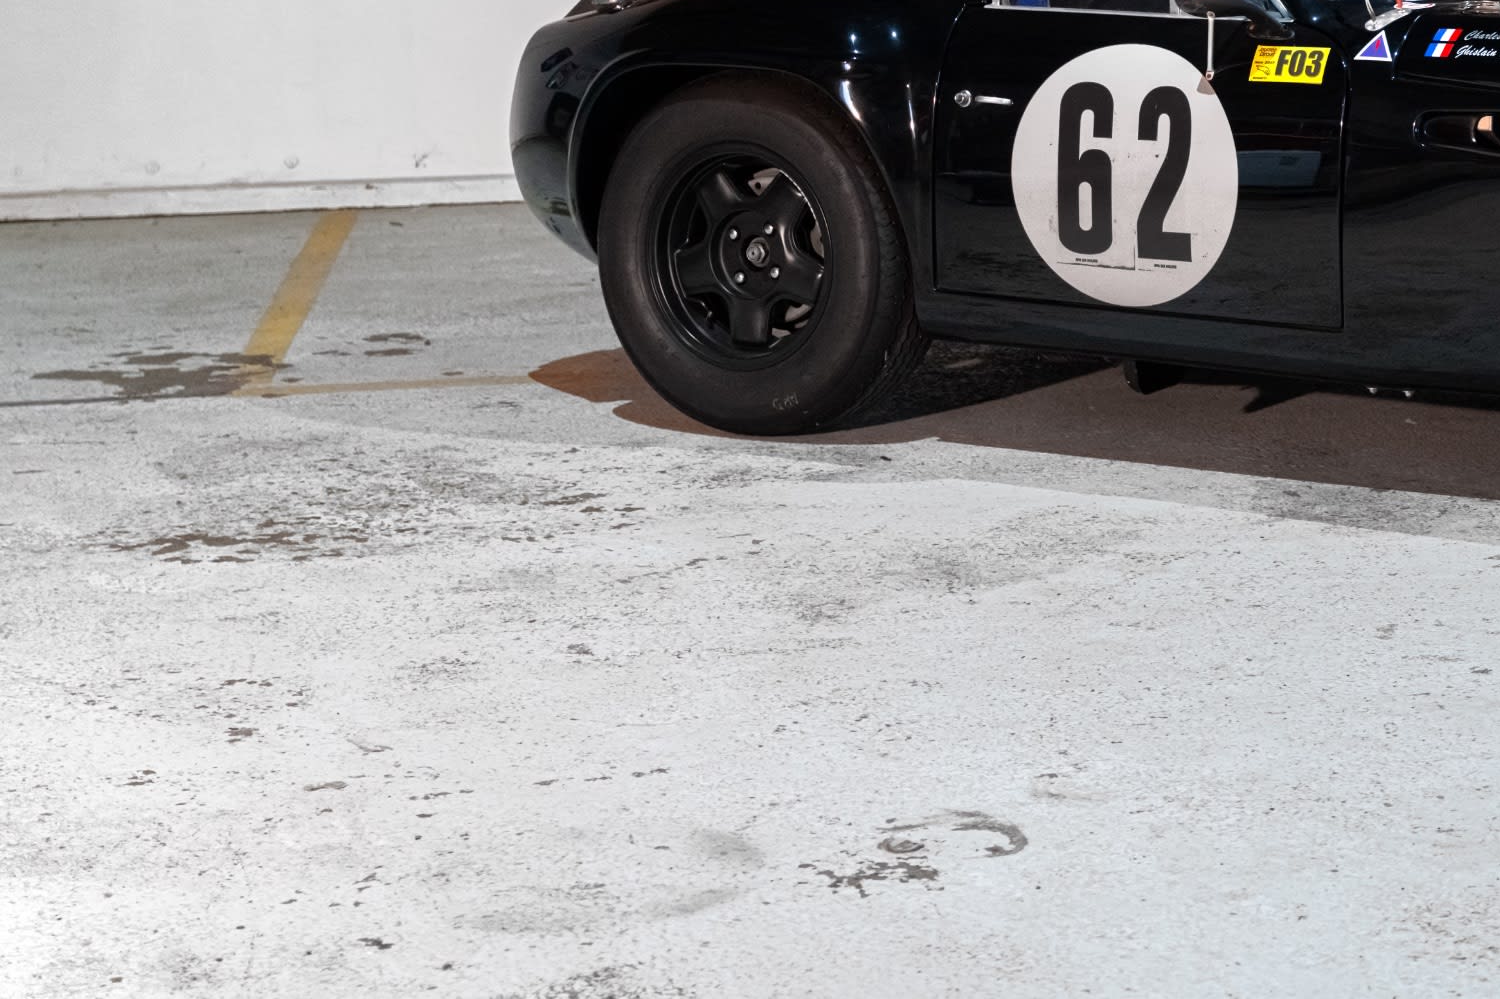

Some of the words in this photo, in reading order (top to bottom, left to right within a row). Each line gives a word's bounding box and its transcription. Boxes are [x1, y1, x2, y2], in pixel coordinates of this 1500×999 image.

[1463, 28, 1500, 41] Charles
[1454, 44, 1497, 59] Ghislain
[1275, 49, 1324, 77] F03
[1057, 81, 1193, 262] 62
